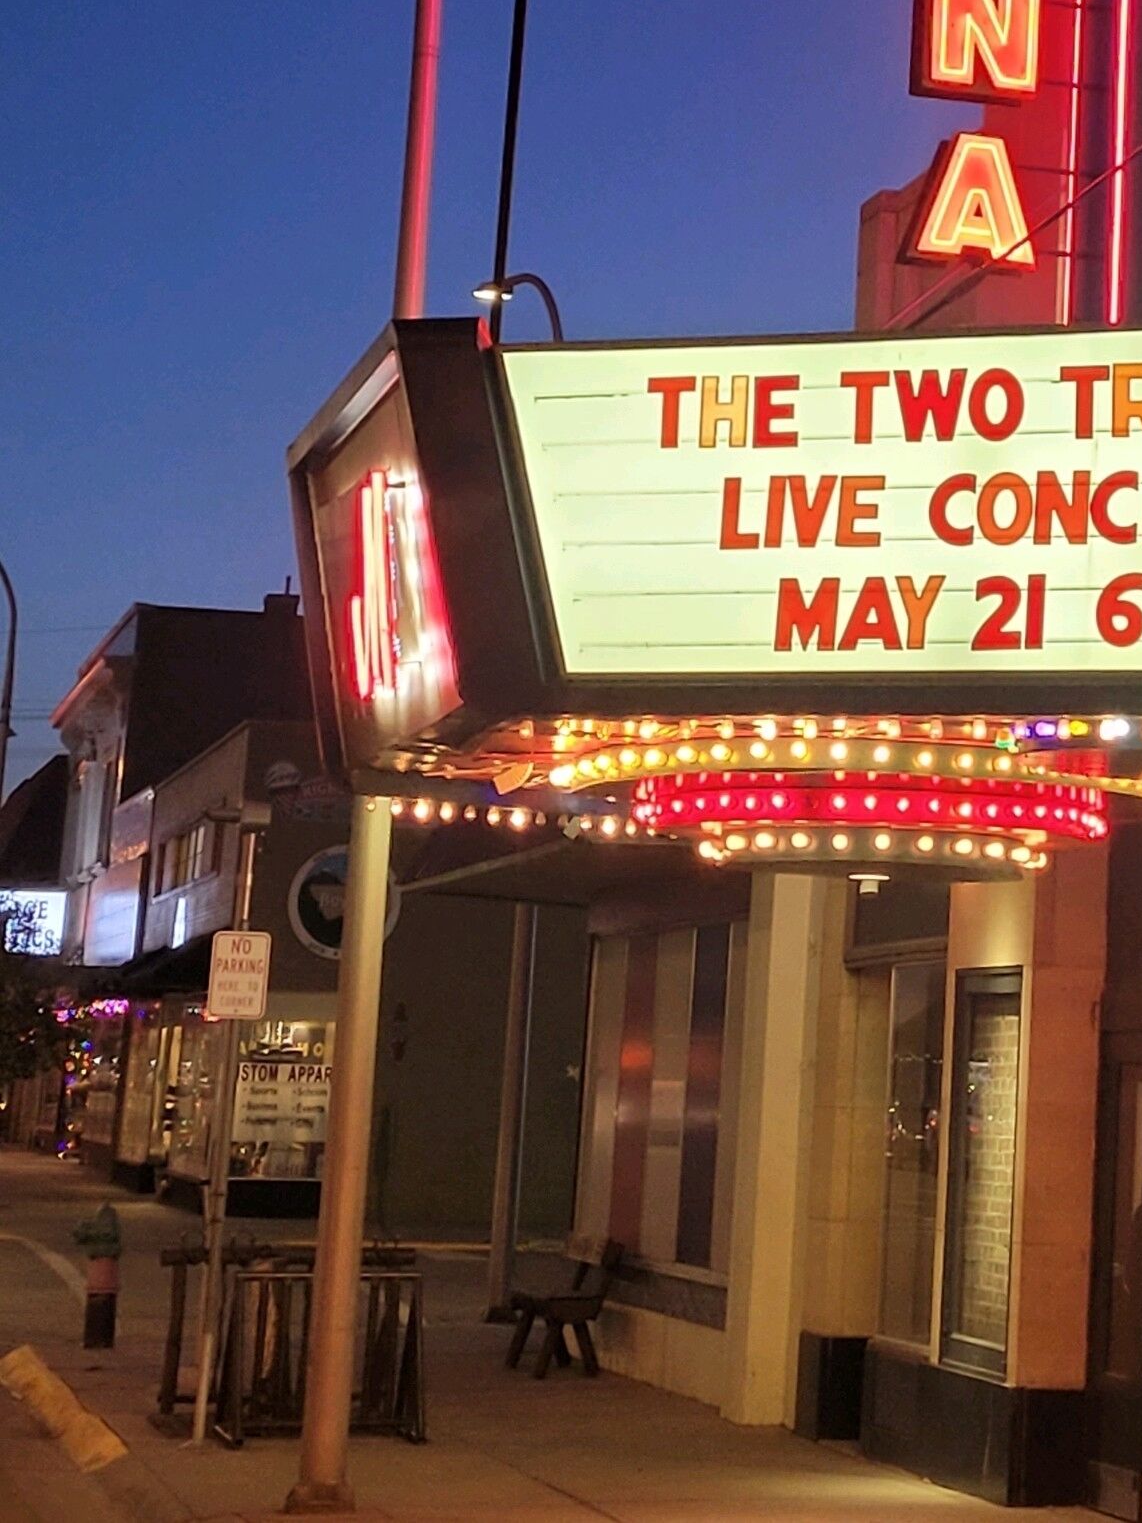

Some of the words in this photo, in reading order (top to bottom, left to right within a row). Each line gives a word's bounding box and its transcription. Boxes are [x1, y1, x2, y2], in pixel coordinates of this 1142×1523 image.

[648, 375, 800, 449] THE
[840, 367, 1025, 444] TWO
[719, 475, 886, 550] LIVE
[774, 574, 947, 652] MAY
[971, 574, 1046, 651] 21
[216, 958, 264, 974] PARKING
[231, 938, 252, 955] NO
